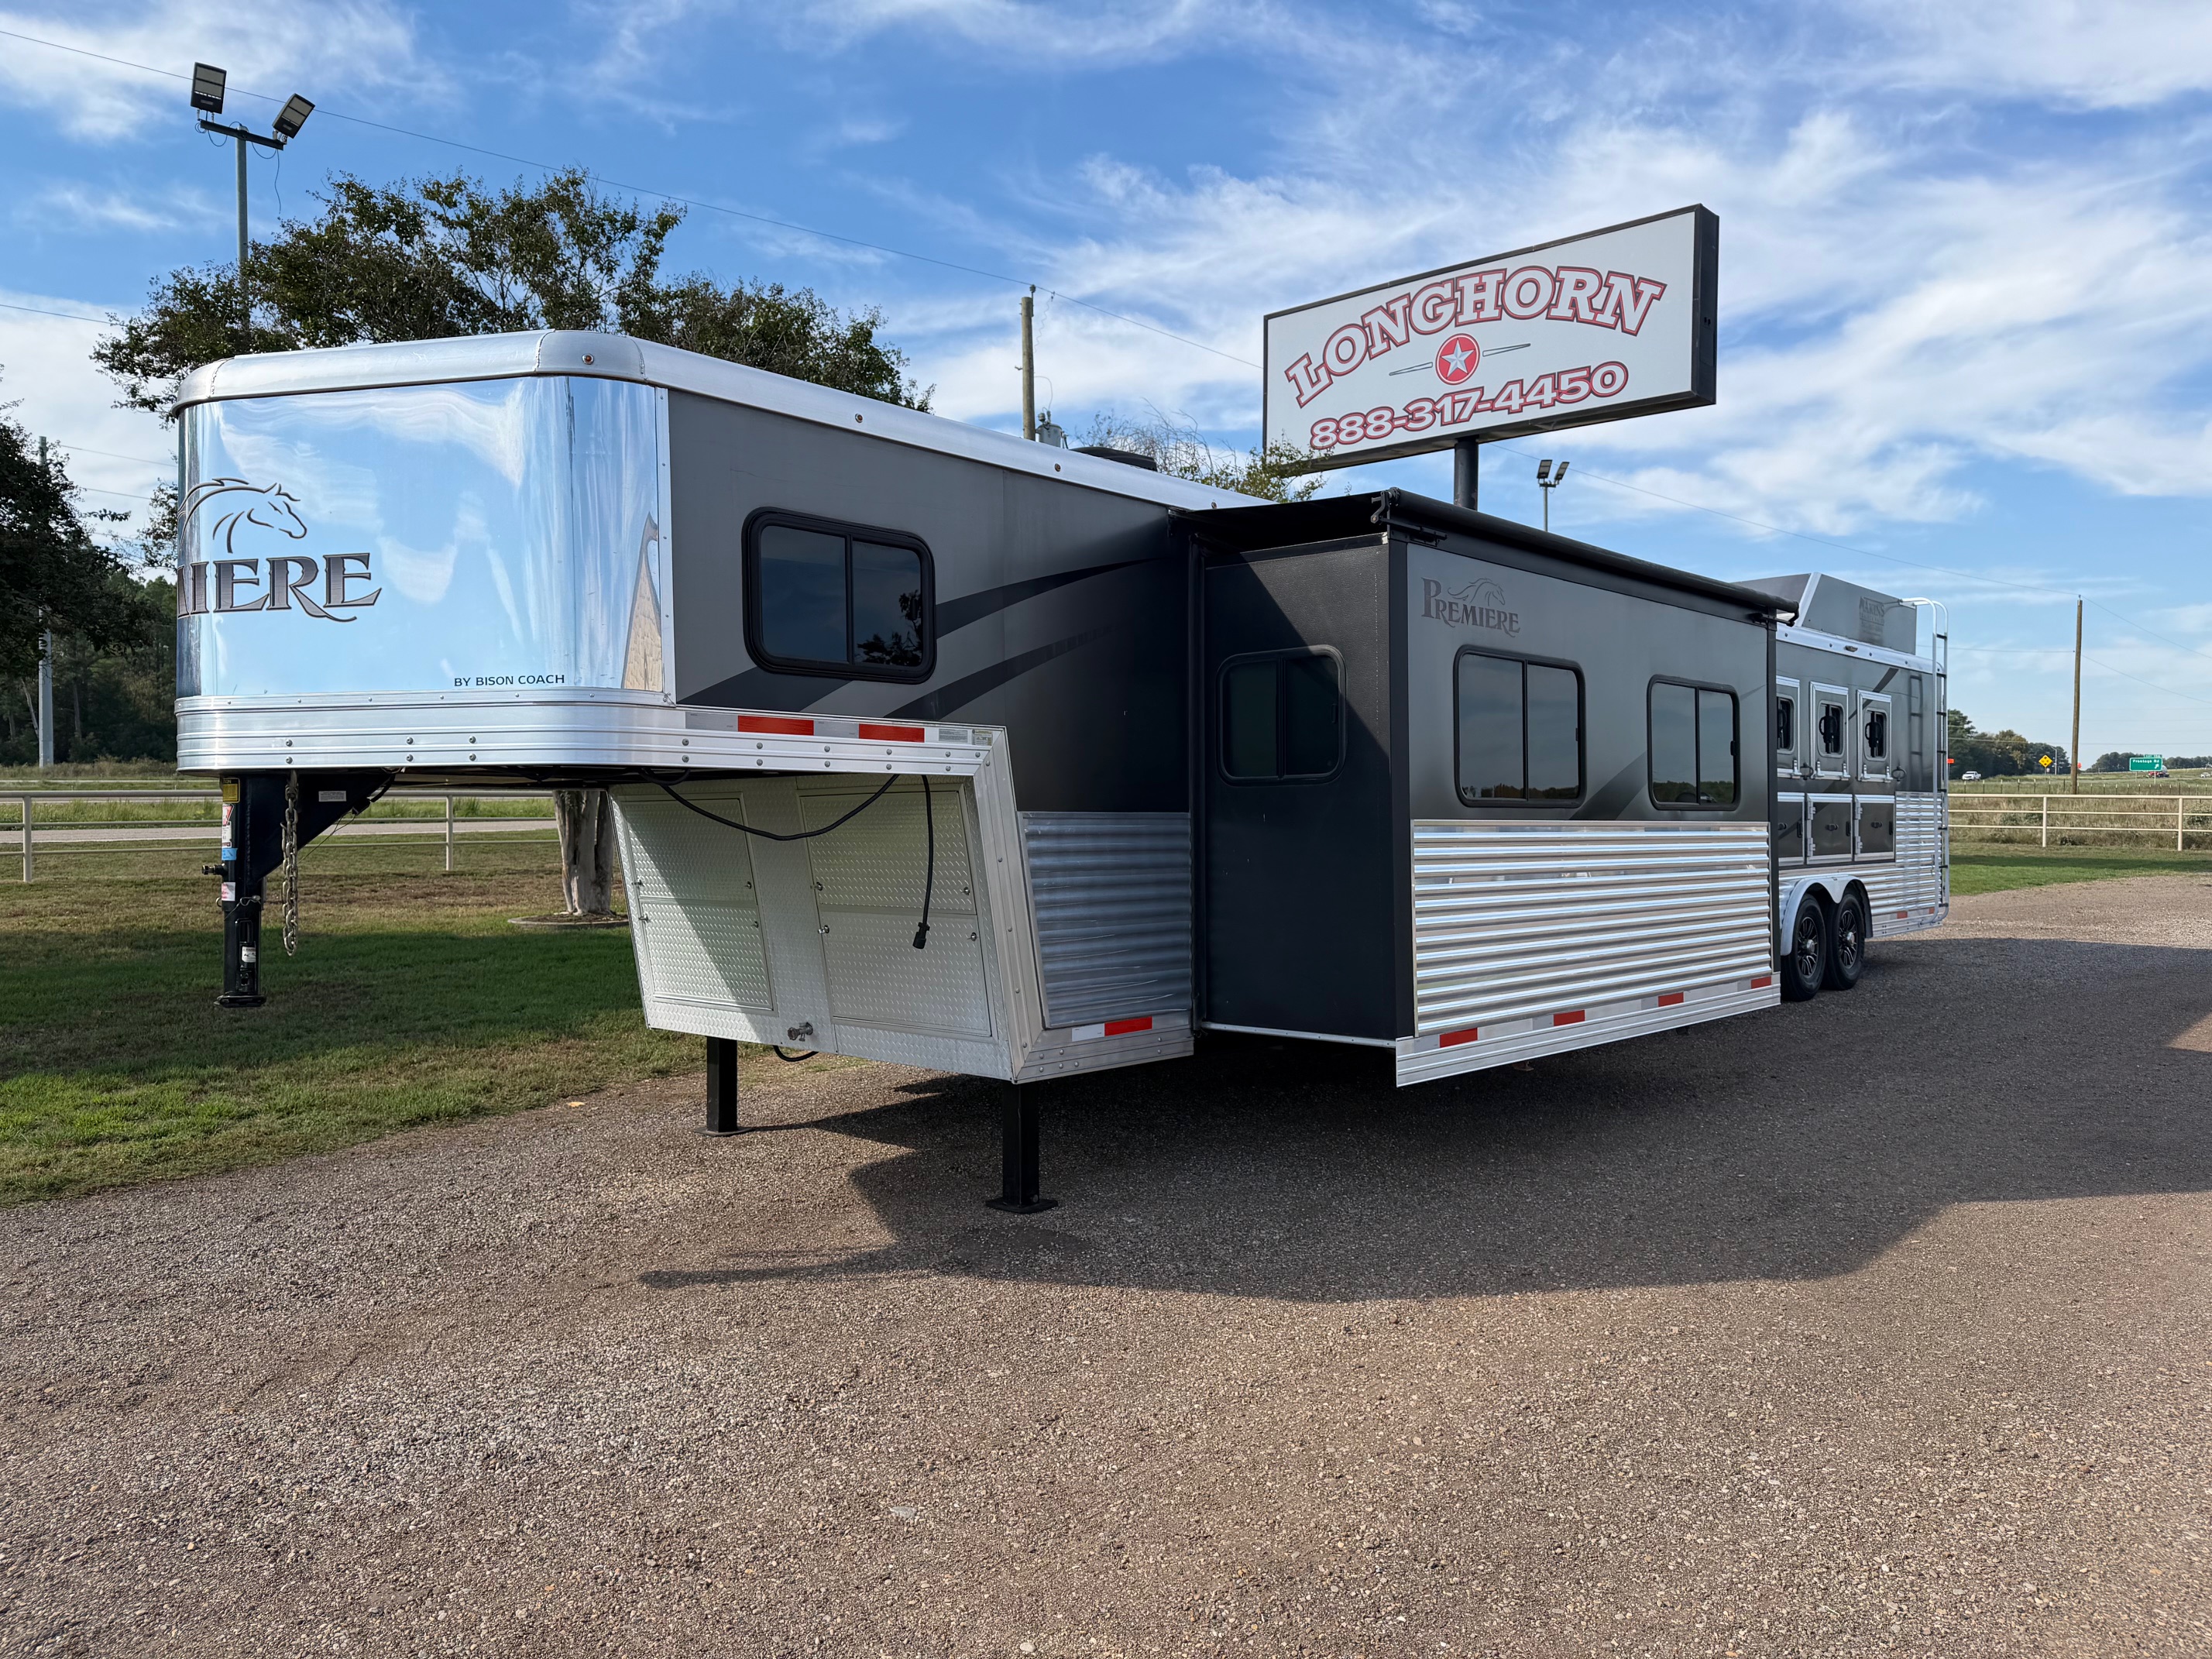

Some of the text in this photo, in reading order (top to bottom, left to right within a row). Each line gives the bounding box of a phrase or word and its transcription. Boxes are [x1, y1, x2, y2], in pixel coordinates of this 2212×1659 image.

[1285, 266, 1667, 407] LONGHORN
[1310, 362, 1629, 449] 888-317-4450
[454, 675, 565, 686] BY BISON COACH
